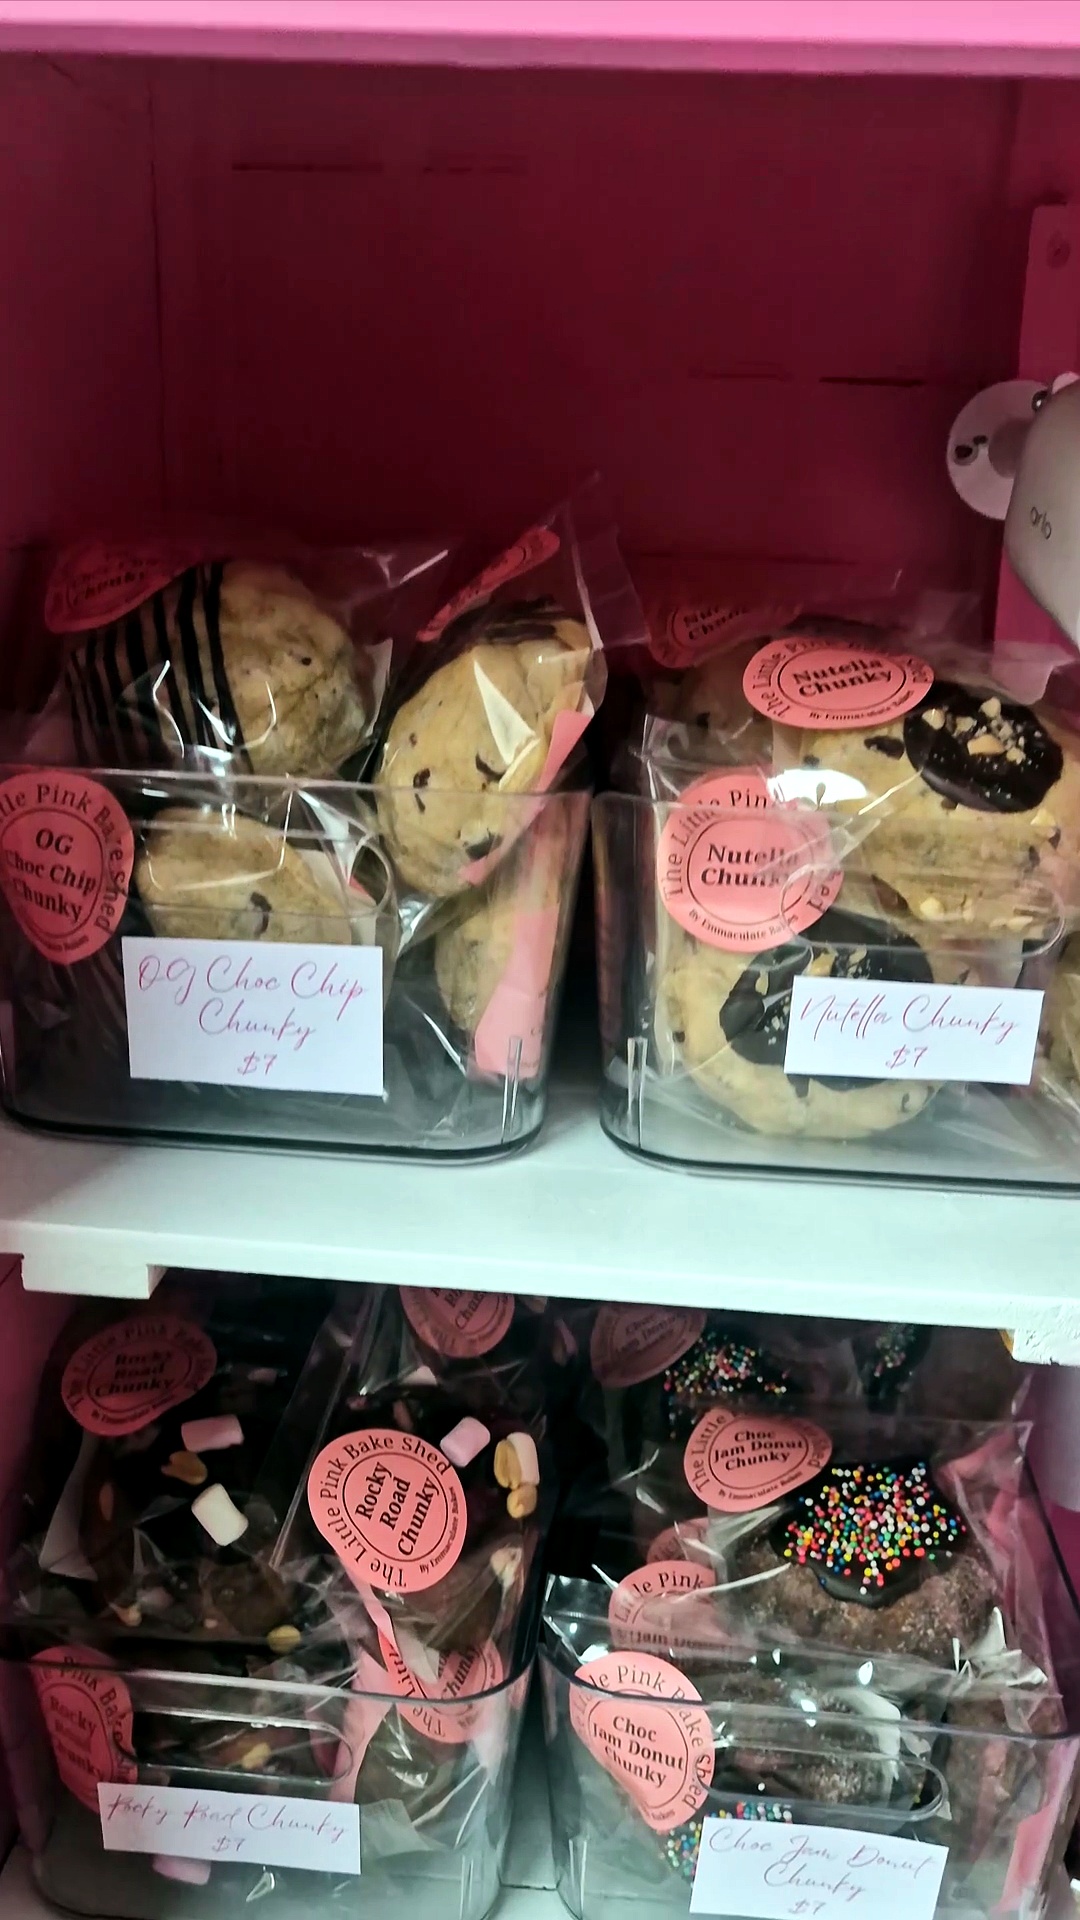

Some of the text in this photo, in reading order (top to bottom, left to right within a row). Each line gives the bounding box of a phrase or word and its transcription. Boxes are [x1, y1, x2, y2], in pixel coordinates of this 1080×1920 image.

[1030, 506, 1052, 540] arlo
[792, 658, 884, 685] Nutella
[798, 671, 893, 698] Chunky
[37, 783, 91, 814] Pink
[35, 827, 74, 857] OG
[661, 853, 684, 901] The
[729, 788, 770, 809] Pin
[707, 843, 799, 866] Nutella
[5, 850, 97, 898] Choc Chip
[12, 877, 83, 924] Chunky
[206, 955, 281, 993] Choc
[290, 960, 367, 1021] Chip
[198, 996, 316, 1051] Chunky
[800, 993, 1019, 1045] Nutella Chunky
[237, 1050, 278, 1076] $7
[885, 1044, 929, 1070] $7
[114, 1363, 166, 1380] Road
[115, 1350, 173, 1365] Rocky
[95, 1378, 176, 1398] Chunky
[691, 1413, 727, 1455] Little
[734, 1430, 777, 1443] Choc
[713, 1439, 804, 1464] Jam Donut
[725, 1451, 791, 1472] Chunky
[355, 1461, 393, 1522] Rocky
[692, 1458, 711, 1494] The
[320, 1434, 452, 1589] The Little Pink Bake Shed
[379, 1476, 412, 1532] Road
[397, 1475, 441, 1557] Chunky
[419, 1563, 430, 1575] By
[658, 1570, 705, 1590] Pink
[617, 1663, 667, 1694] Pink
[612, 1715, 657, 1742] Choc
[671, 1686, 704, 1749] Bake
[592, 1722, 622, 1750] Jam
[628, 1739, 685, 1771] Donut
[604, 1744, 668, 1789] Chunky
[682, 1753, 712, 1812] Shed
[107, 1793, 350, 1844] Rocky Road Chunky
[211, 1835, 246, 1854] $7
[709, 1826, 934, 1879] Choc Jam Donut
[764, 1860, 867, 1902] Chunky
[787, 1899, 827, 1916] $7
